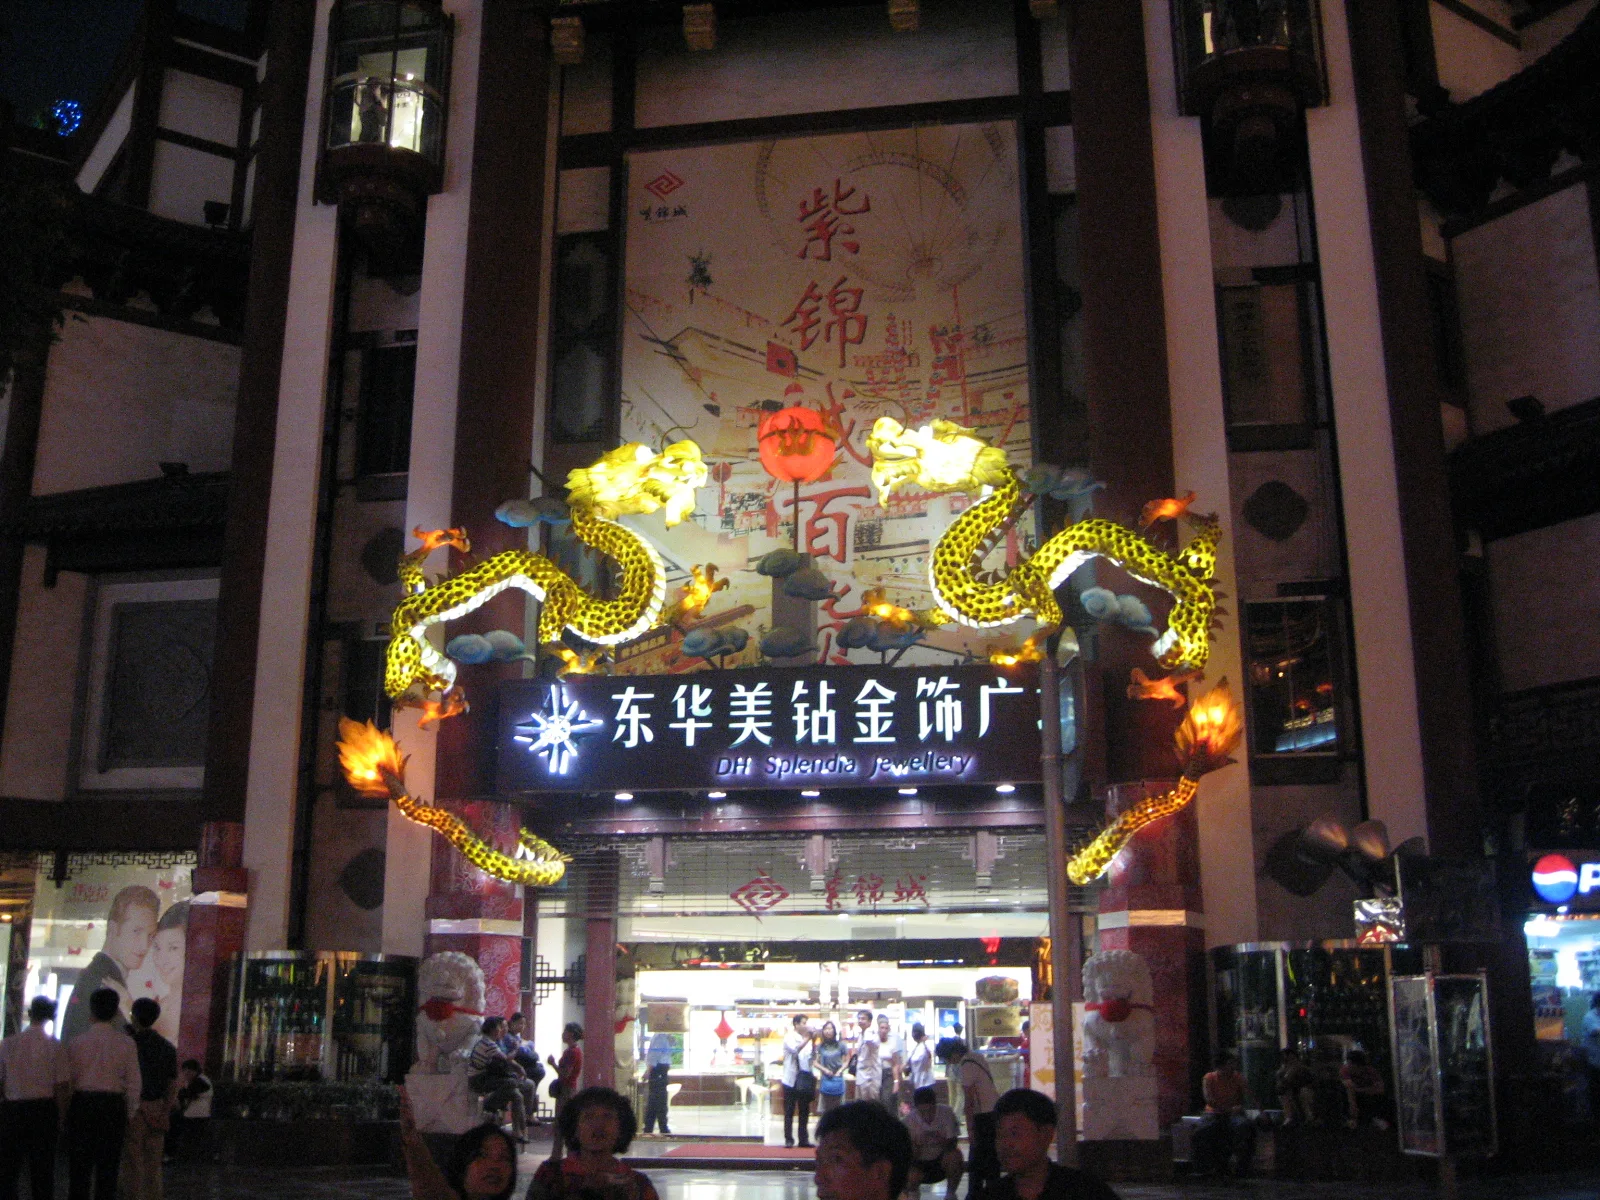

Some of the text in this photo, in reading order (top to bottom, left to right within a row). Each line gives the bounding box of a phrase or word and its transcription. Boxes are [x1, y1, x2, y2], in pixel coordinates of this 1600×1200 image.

[611, 676, 1042, 748] 东华美钻金饰广
[716, 757, 751, 776] DH
[869, 751, 973, 780] Jewellery
